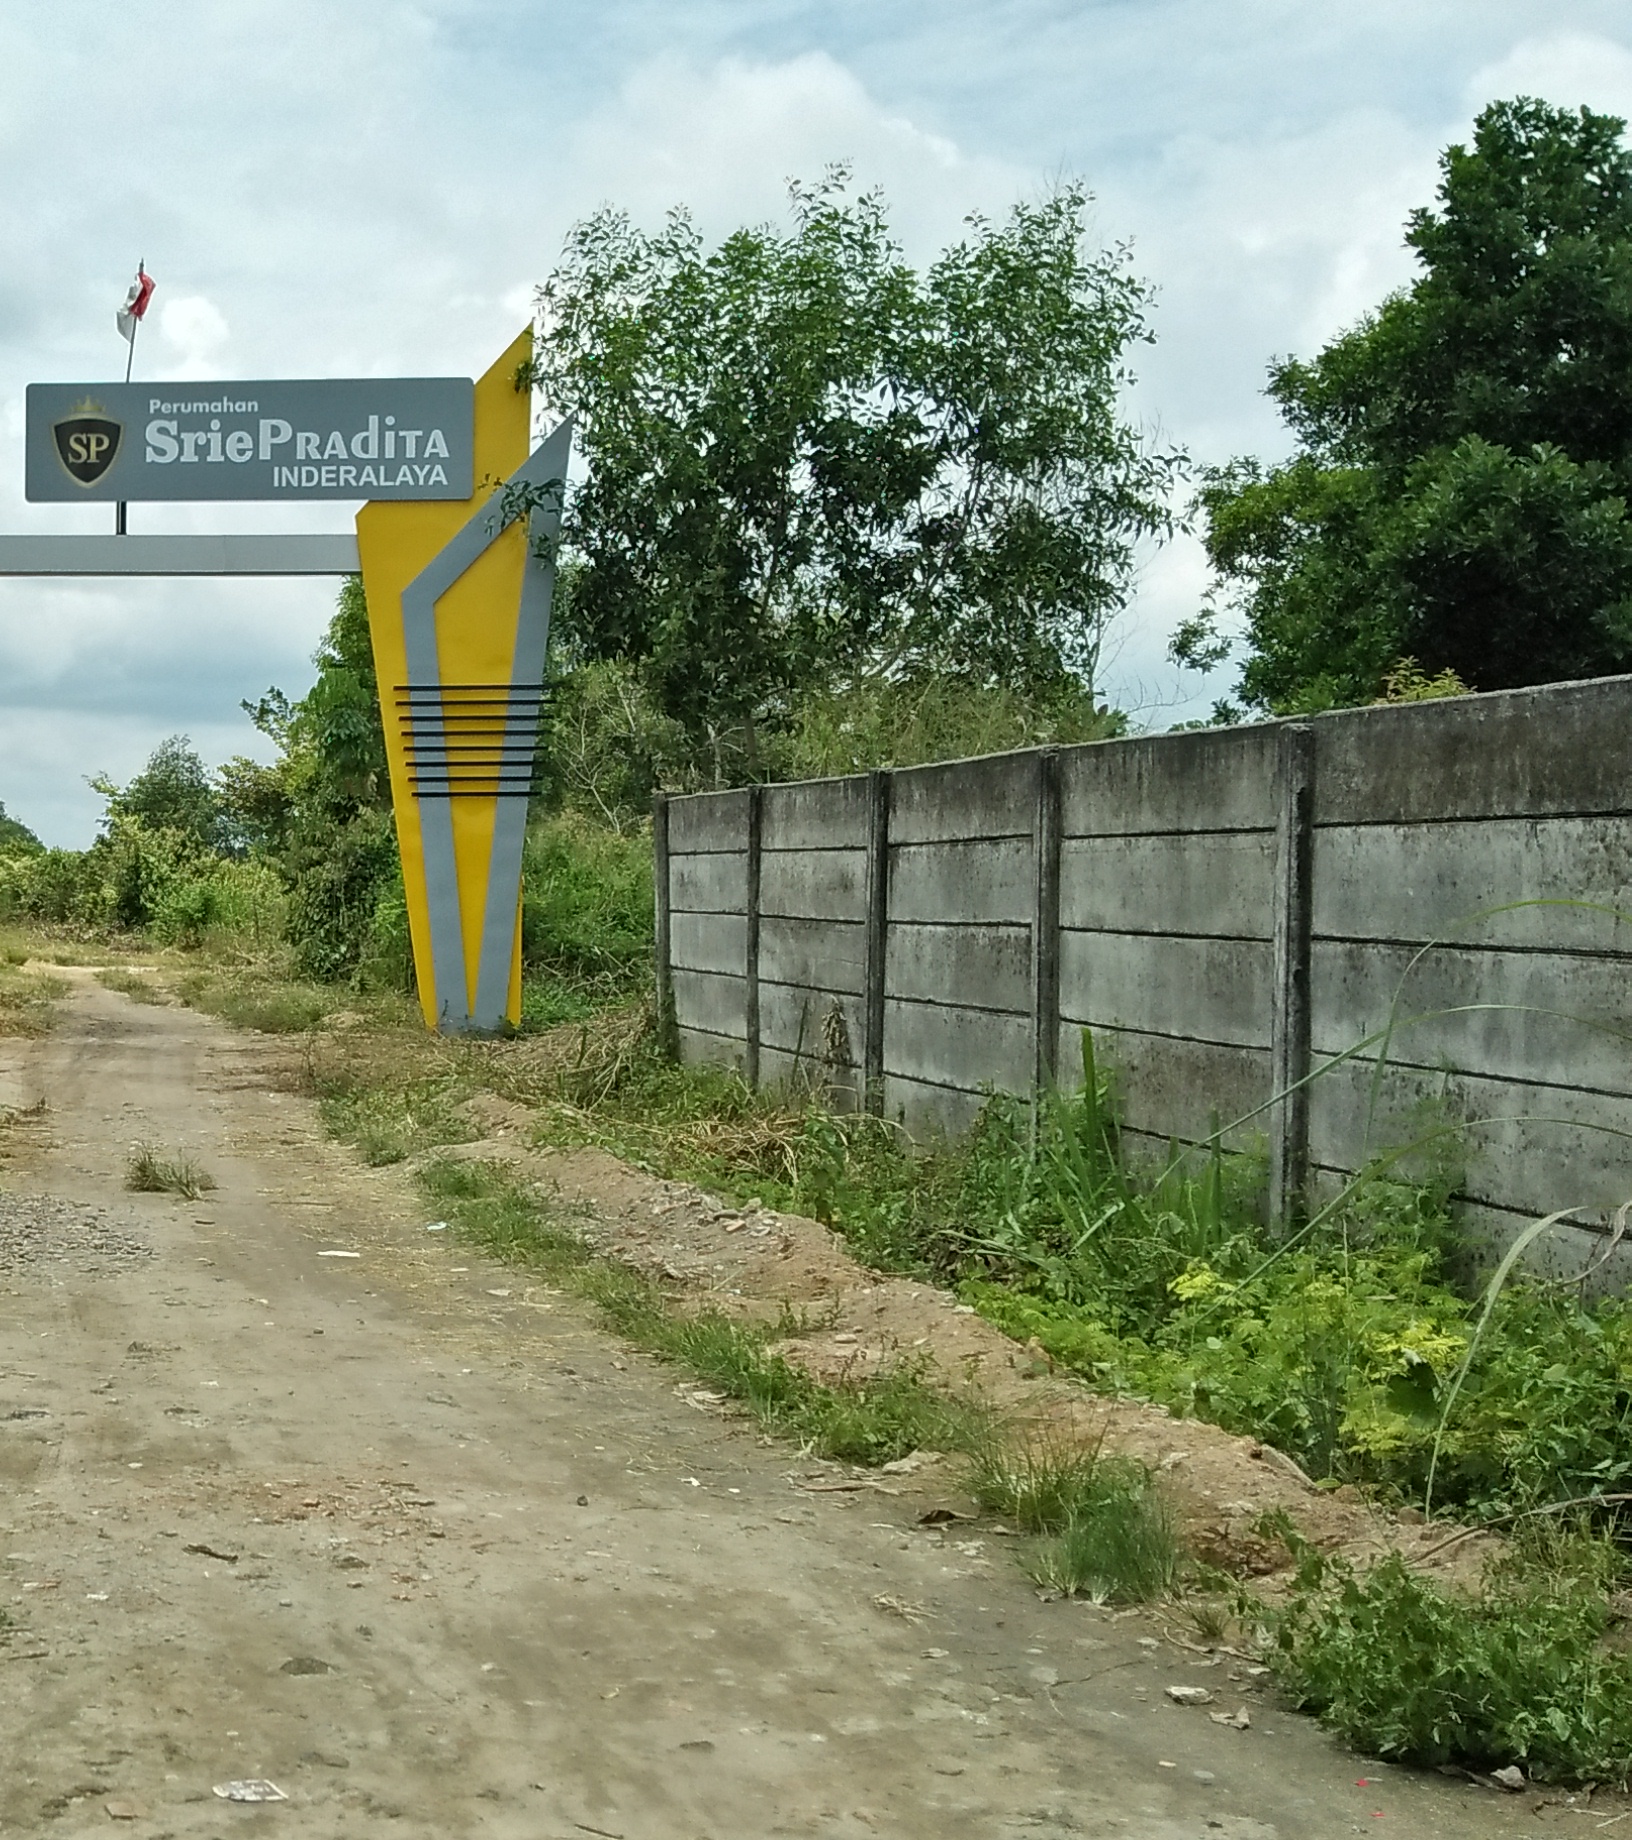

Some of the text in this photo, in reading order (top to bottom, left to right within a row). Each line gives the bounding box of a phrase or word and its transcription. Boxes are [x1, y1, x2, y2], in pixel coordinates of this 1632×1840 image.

[148, 397, 259, 415] Perumahan
[68, 433, 111, 464] SP
[273, 465, 449, 487] INDERALAYA
